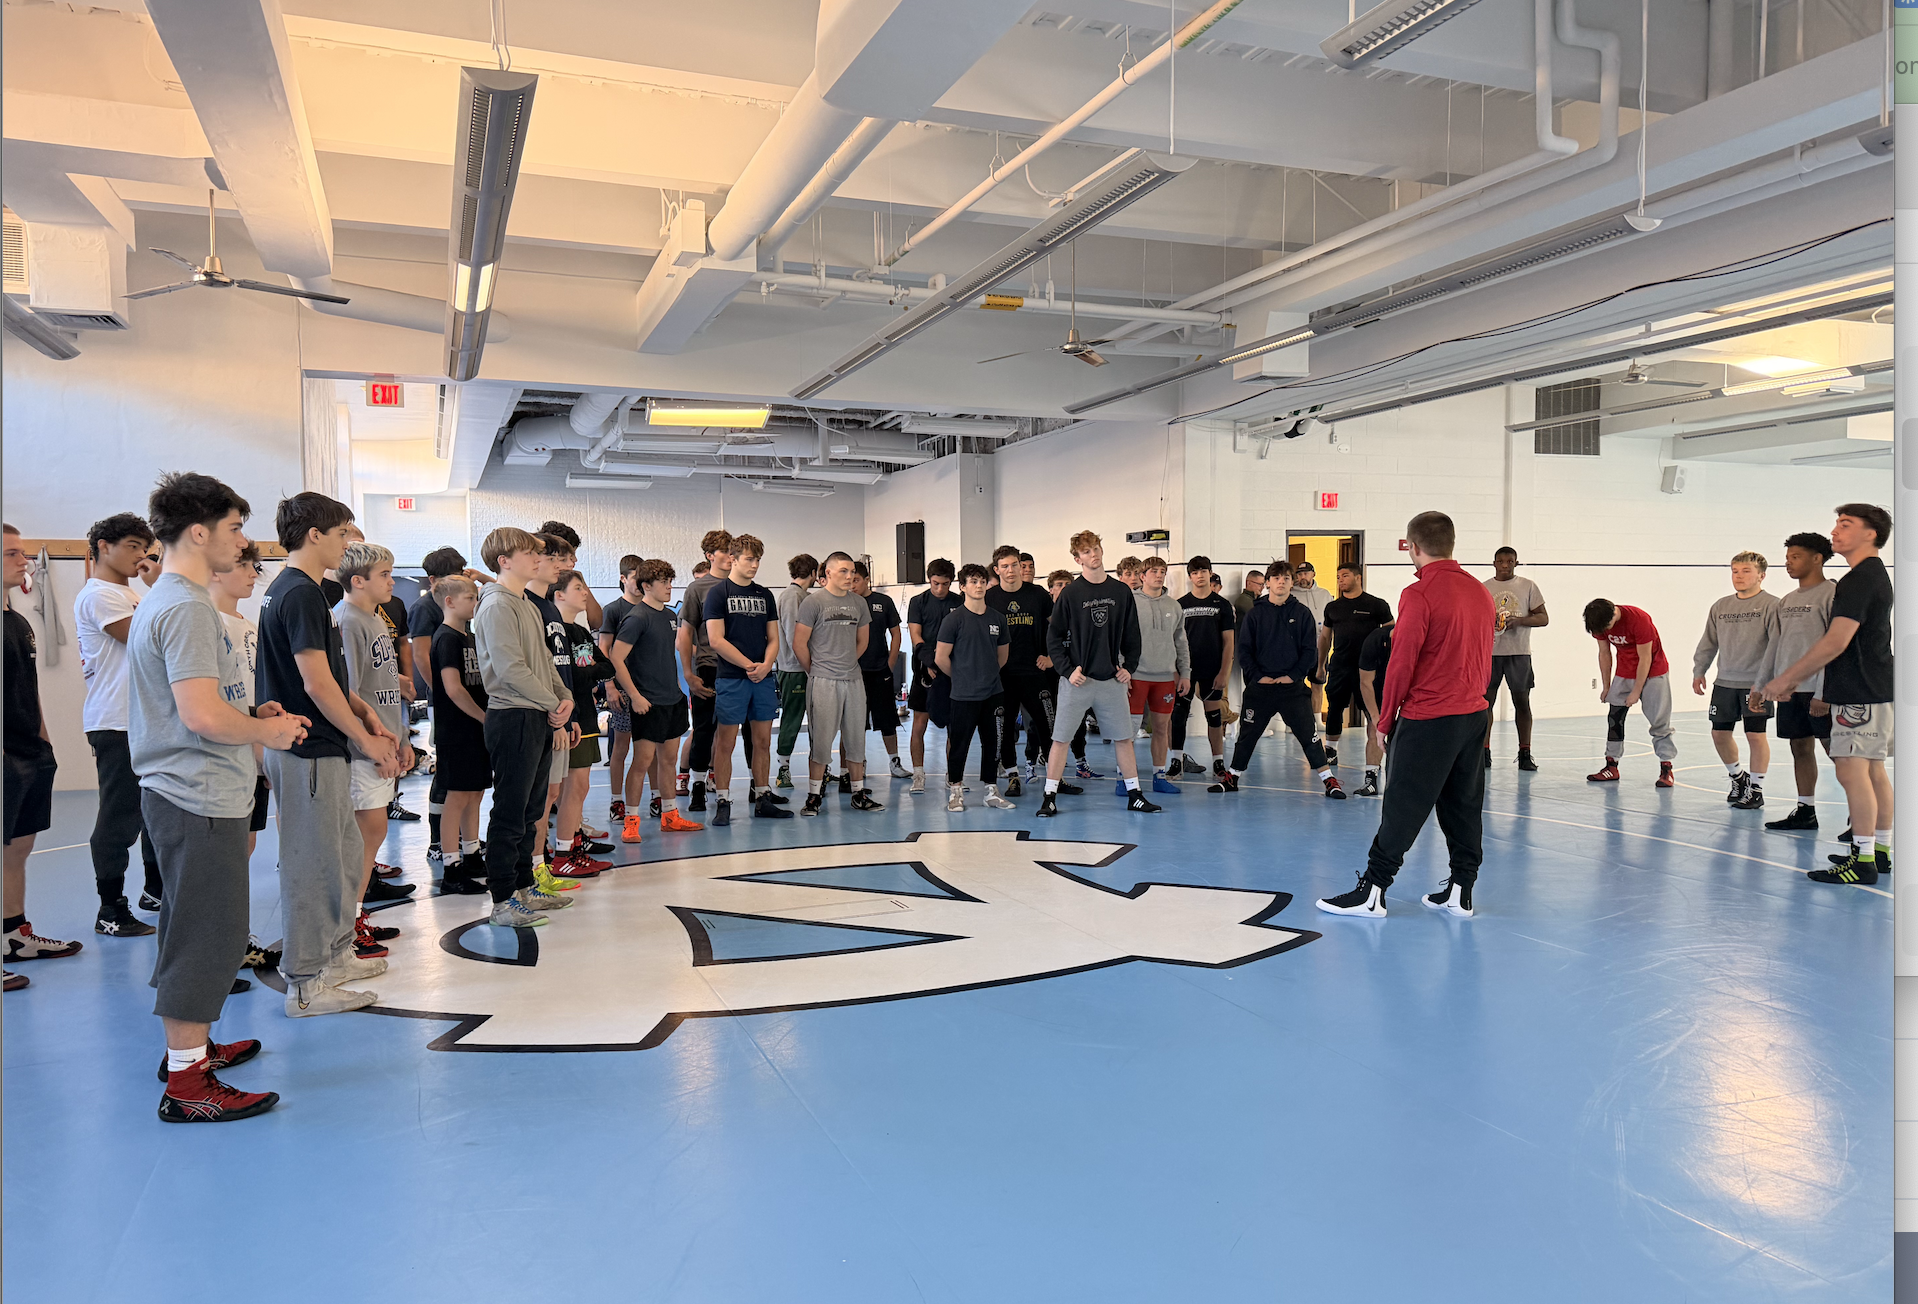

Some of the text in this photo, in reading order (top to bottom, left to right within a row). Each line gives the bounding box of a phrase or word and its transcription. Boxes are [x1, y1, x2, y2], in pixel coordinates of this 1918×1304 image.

[372, 383, 400, 406] EXIT
[398, 498, 413, 510] EXIT
[1321, 492, 1339, 509] EXIT
[1006, 616, 1034, 626] ESTLING
